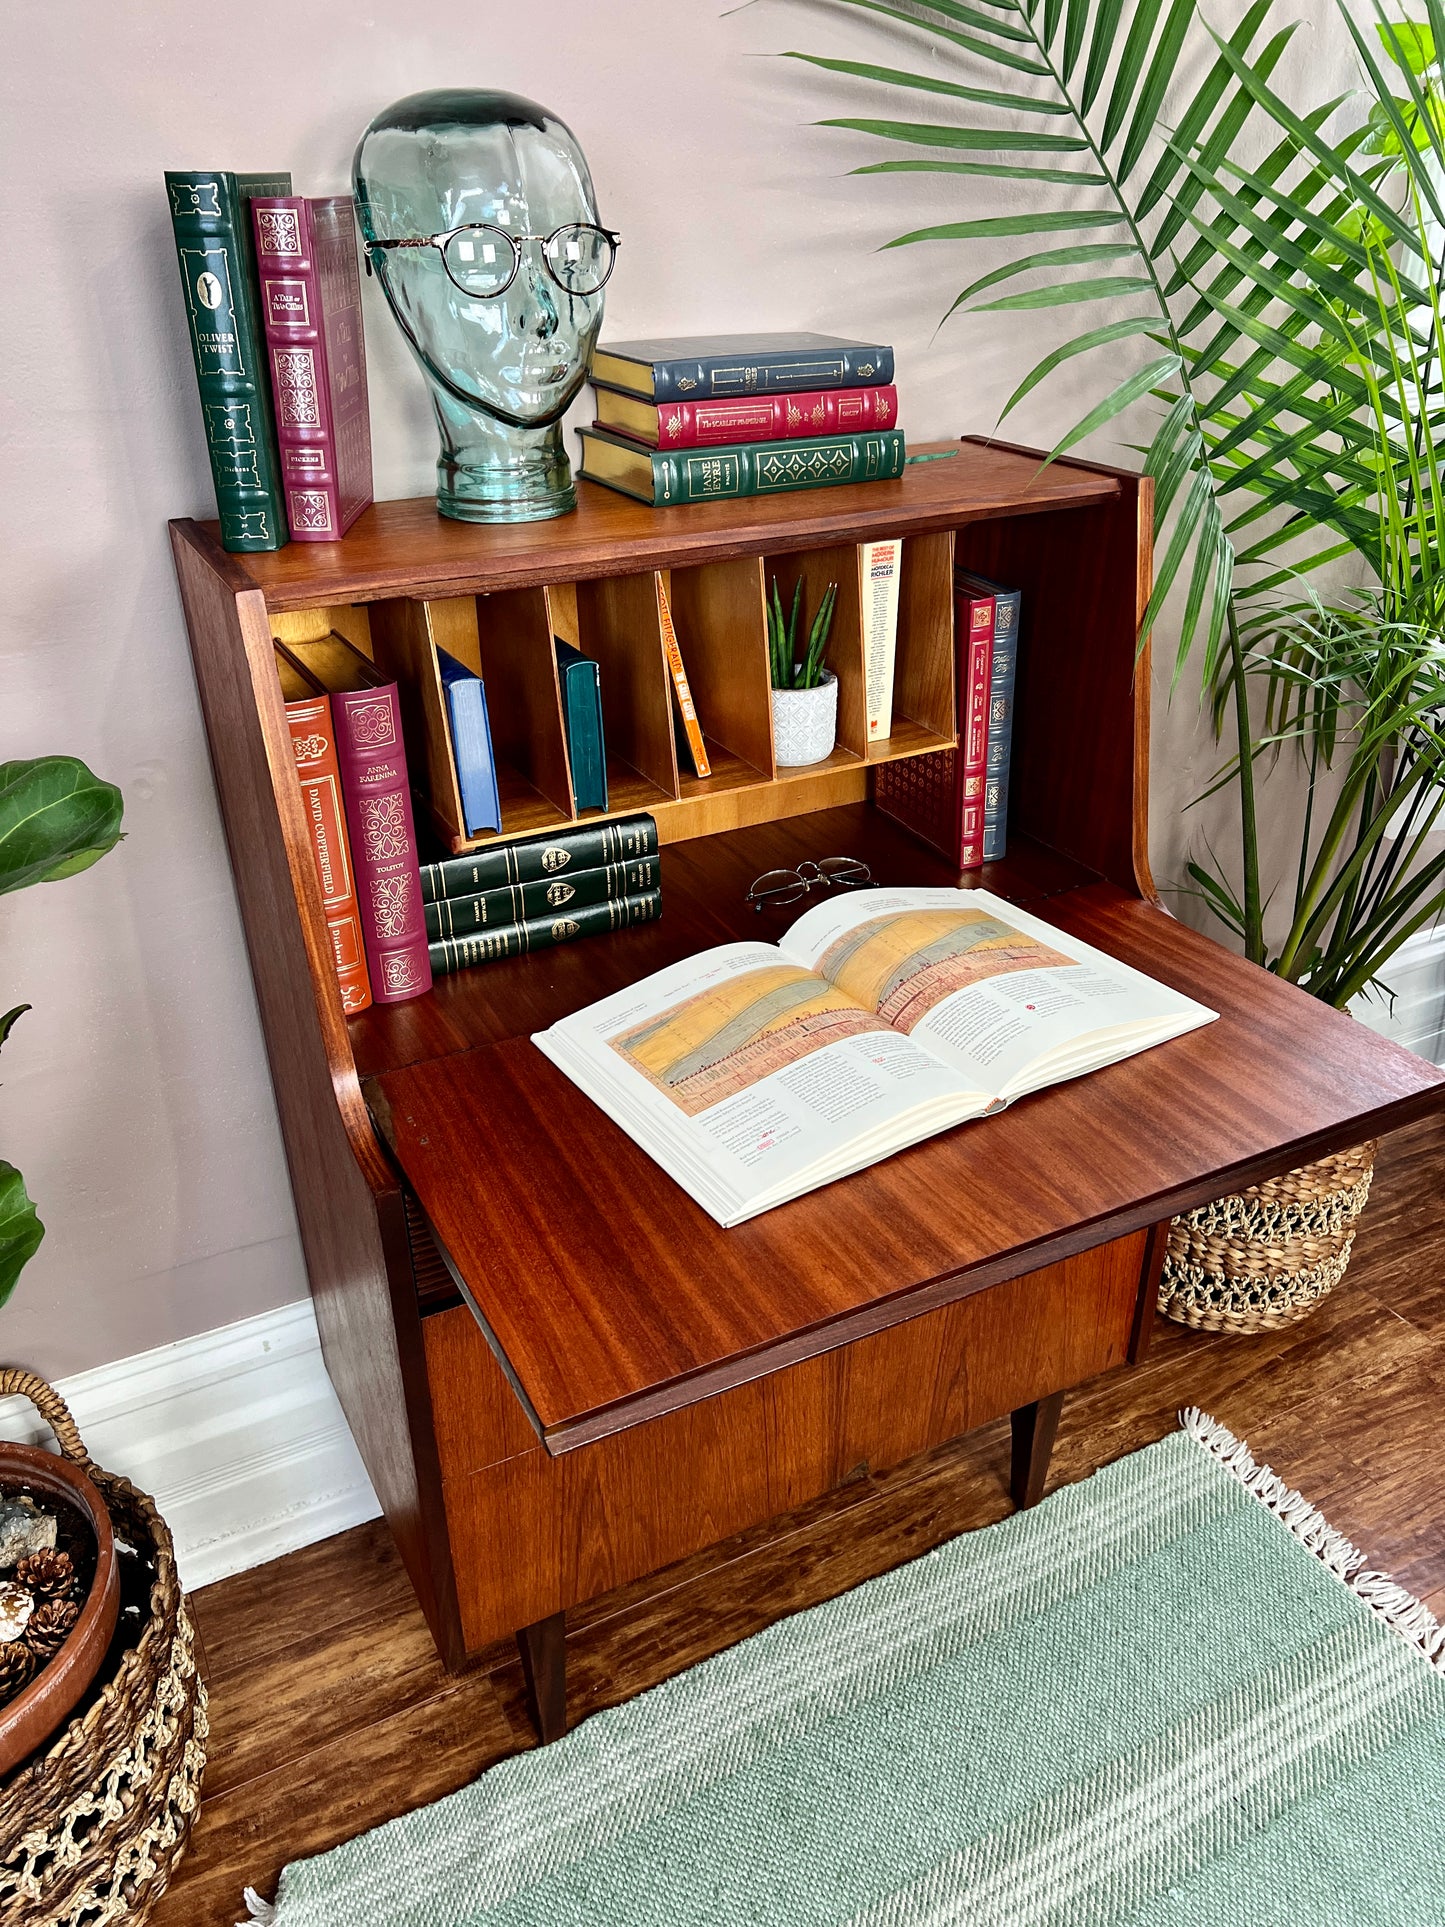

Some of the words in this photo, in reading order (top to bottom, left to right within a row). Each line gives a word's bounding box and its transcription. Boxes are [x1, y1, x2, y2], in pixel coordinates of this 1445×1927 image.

[198, 333, 235, 342] OLIVER
[202, 344, 234, 354] TWIST
[712, 419, 737, 428] SCARLET
[702, 461, 713, 492] JANE
[712, 460, 721, 490] EYRE
[305, 507, 316, 515] DP
[871, 550, 895, 558] MODERN
[871, 556, 894, 564] HUMOUR
[871, 564, 894, 572] MORDECAI
[871, 569, 894, 578] RICHLER
[664, 618, 682, 669] FITZGERALD
[367, 764, 389, 774] ANNA
[359, 769, 398, 783] KARENINA
[308, 788, 324, 822] DAVID
[314, 823, 335, 894] COPPERFIELD
[376, 862, 404, 873] TOLSTOY
[332, 929, 343, 965] Dickens
